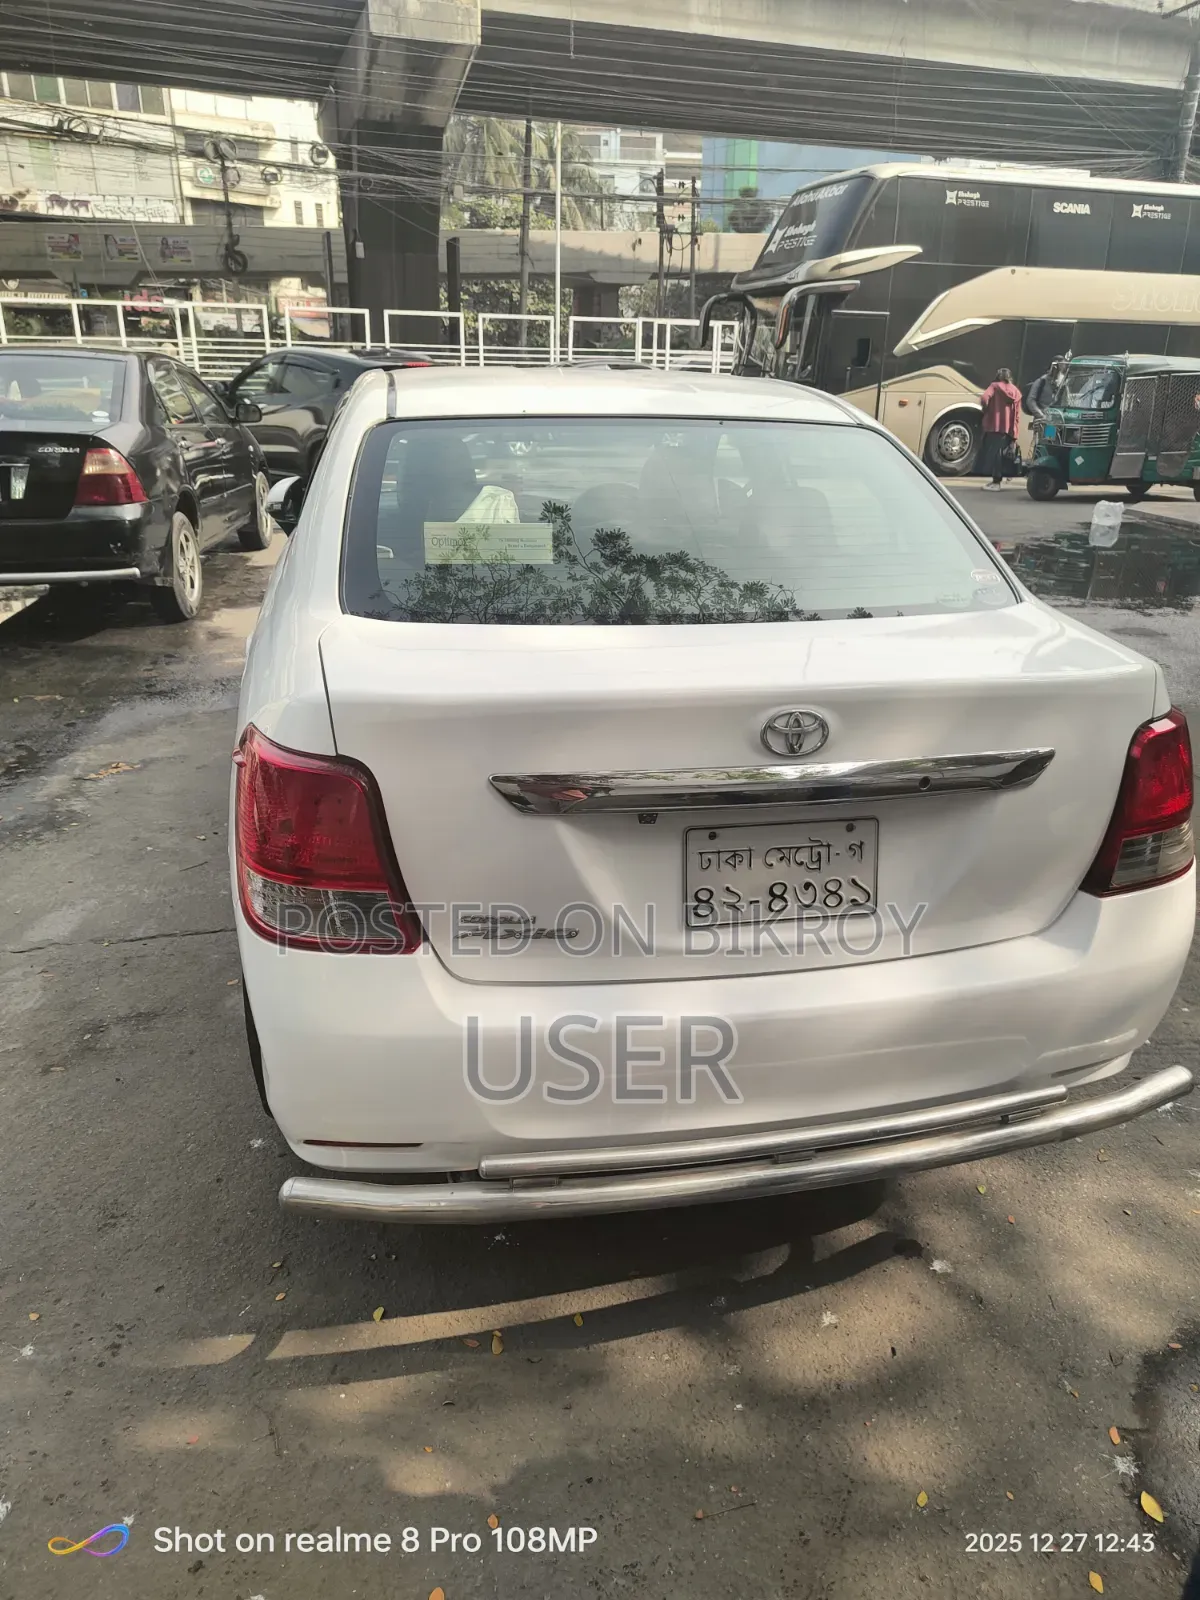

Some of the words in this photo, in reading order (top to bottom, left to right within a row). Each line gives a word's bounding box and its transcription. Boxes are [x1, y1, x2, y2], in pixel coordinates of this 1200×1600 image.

[957, 198, 990, 208] PRESTIGE
[1053, 201, 1091, 215] SCANIA
[37, 446, 80, 454] COROLLA
[697, 846, 753, 871] ঢাকা
